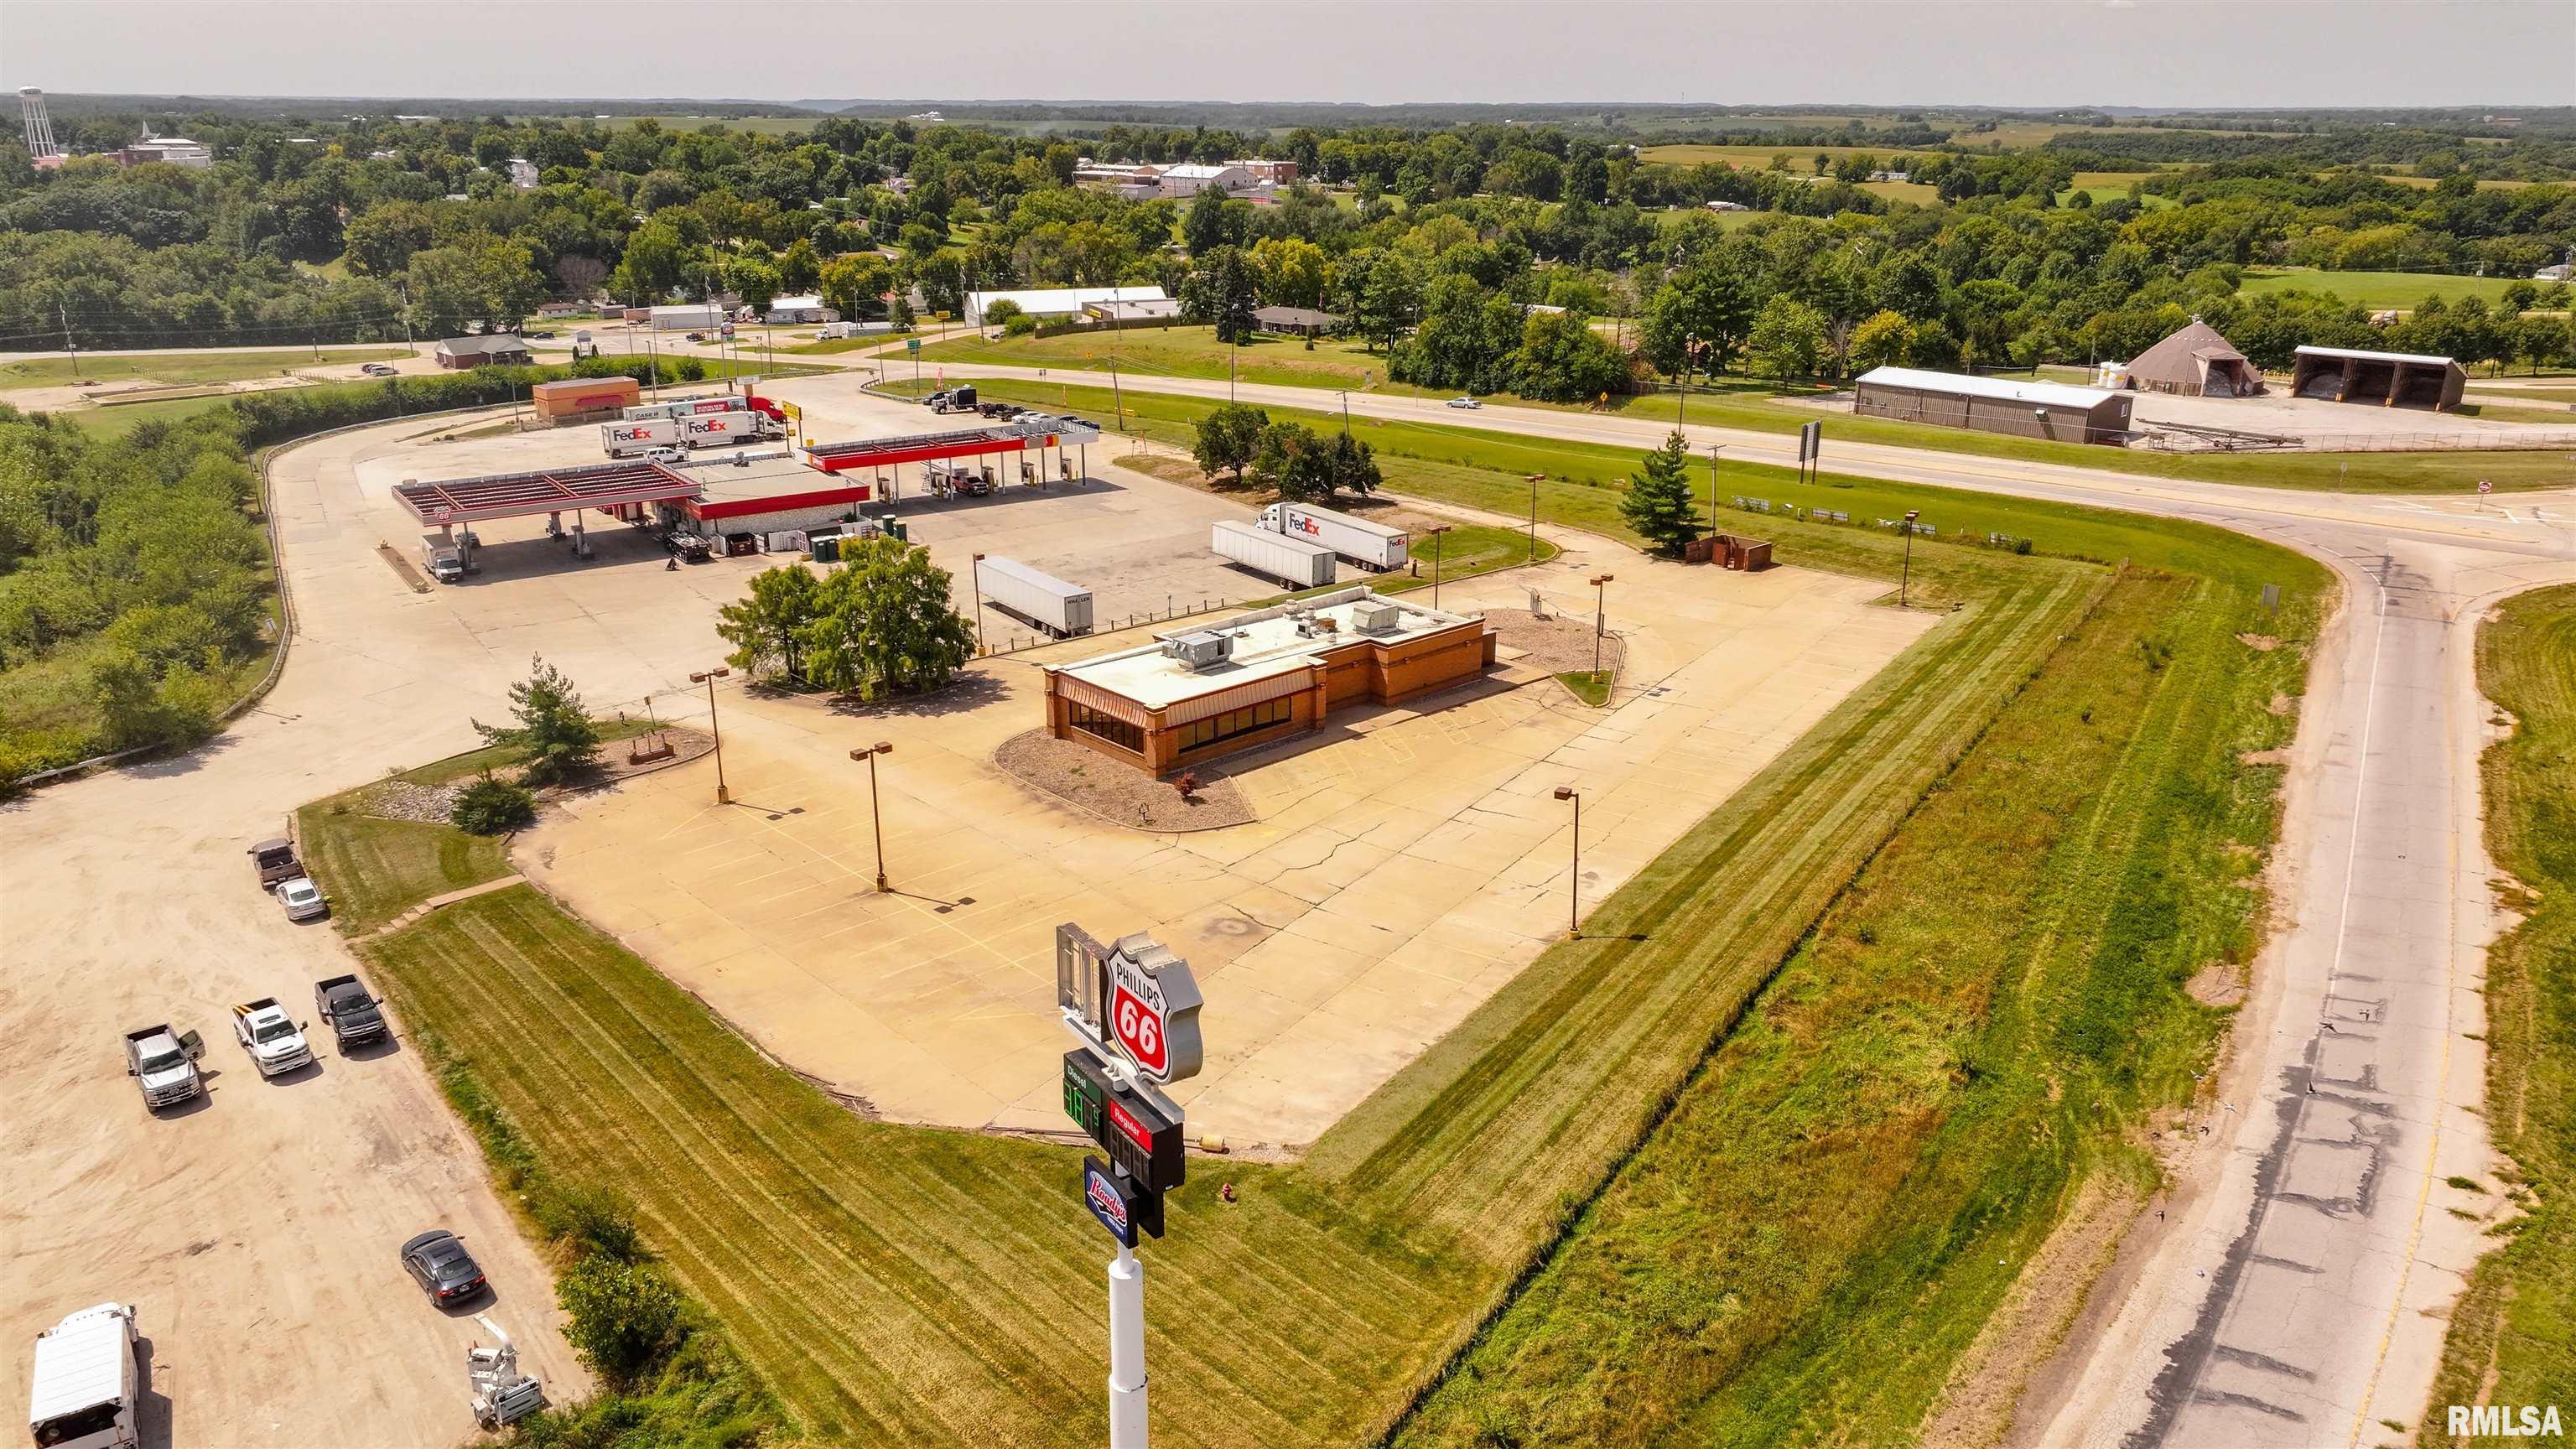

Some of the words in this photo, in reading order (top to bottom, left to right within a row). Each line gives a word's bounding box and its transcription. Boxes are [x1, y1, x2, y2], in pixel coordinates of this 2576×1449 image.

[613, 428, 652, 441] FedEx
[688, 419, 726, 434] FedEx
[1289, 513, 1320, 537] FedEx
[1389, 538, 1405, 548] FedEx
[1116, 962, 1160, 1011] PHILLIPS
[1120, 1000, 1157, 1055] 66
[1067, 1065, 1087, 1088] Diesel
[1114, 1108, 1140, 1136] Regular
[1090, 1176, 1126, 1221] Roady's
